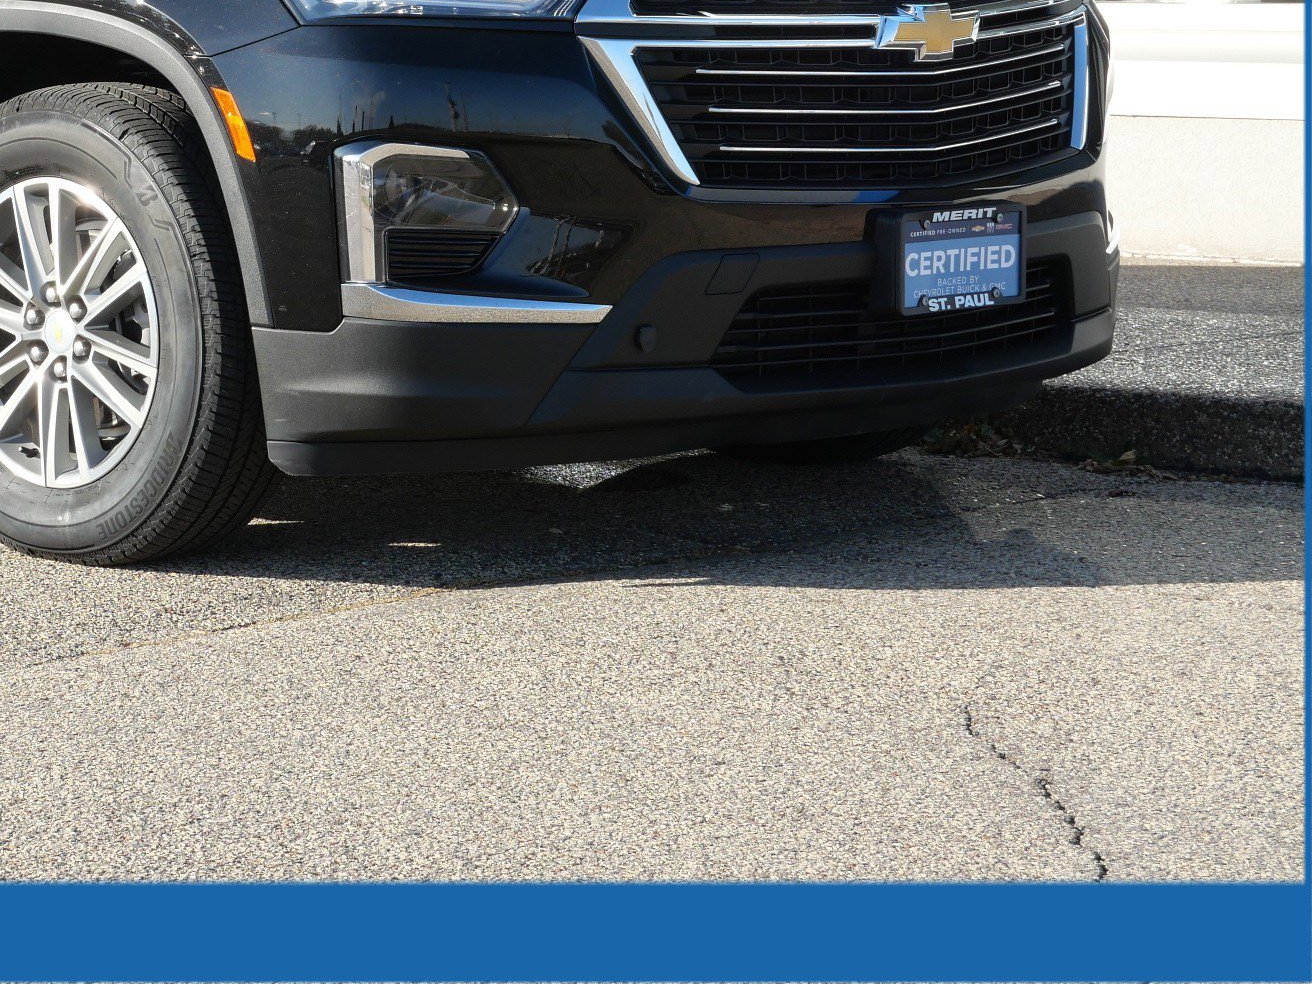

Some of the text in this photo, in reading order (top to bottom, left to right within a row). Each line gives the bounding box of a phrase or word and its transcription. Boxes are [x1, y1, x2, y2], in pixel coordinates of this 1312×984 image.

[932, 207, 997, 223] MERIT
[905, 244, 1016, 277] CERTIFIED
[937, 275, 980, 287] BACKED BY
[913, 286, 955, 299] CHEVROLET
[957, 284, 980, 294] BUICK
[928, 293, 995, 312] ST. PAUL
